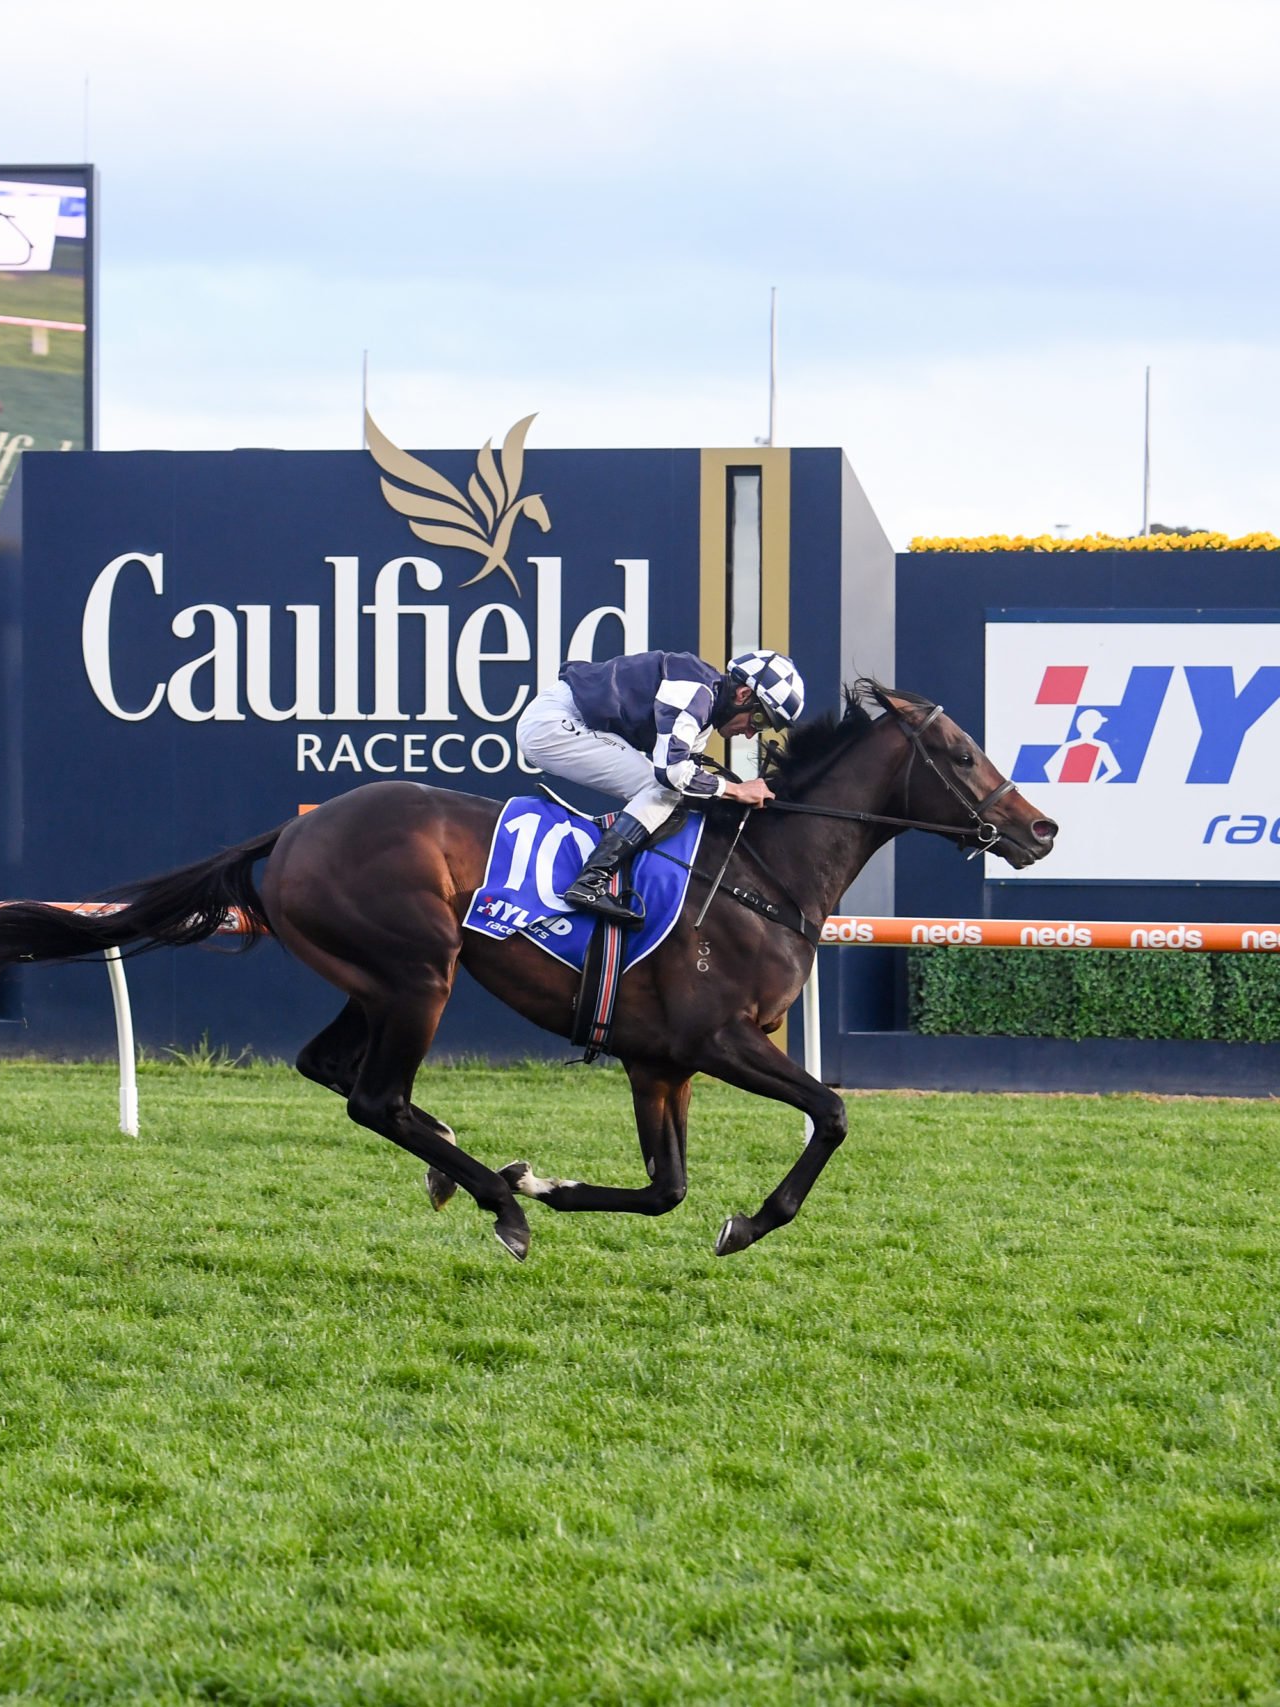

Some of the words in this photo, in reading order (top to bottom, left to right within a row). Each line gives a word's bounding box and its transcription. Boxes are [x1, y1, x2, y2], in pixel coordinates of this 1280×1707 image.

[81, 552, 649, 724] Caulfield
[296, 733, 543, 774] RACECO
[1202, 814, 1280, 844] ra
[504, 813, 597, 912] 10
[821, 919, 874, 942] eds
[911, 921, 982, 944] neds
[1021, 924, 1092, 947] neds
[1130, 925, 1203, 948] neds
[1241, 929, 1280, 949] ne
